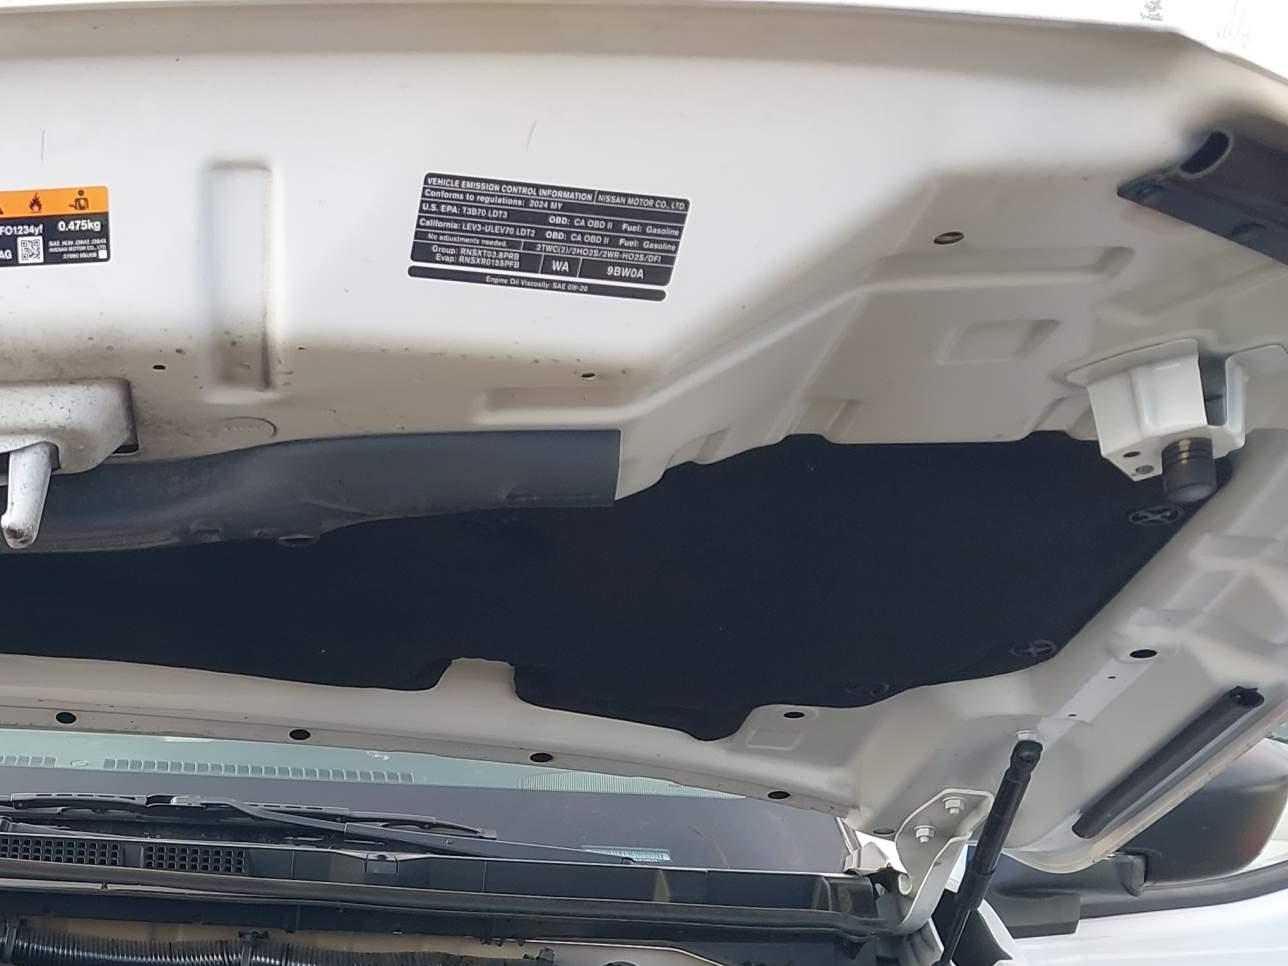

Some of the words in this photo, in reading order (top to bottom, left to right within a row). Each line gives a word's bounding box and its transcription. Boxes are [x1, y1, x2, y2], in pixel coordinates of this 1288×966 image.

[427, 177, 459, 187] VEHICLE
[462, 181, 499, 191] EMISSION
[502, 185, 536, 195] CONTROL
[539, 188, 592, 201] INFORMATION
[425, 189, 464, 199] Conforms
[466, 193, 474, 201] to
[477, 195, 525, 206] regulations:
[529, 200, 547, 208] 2024
[550, 202, 563, 210] MY
[598, 194, 626, 204] NISSAN
[627, 197, 654, 207] MOTOR
[671, 202, 685, 210] LTD.
[422, 203, 438, 211] U.S.
[441, 205, 460, 213] EPA:
[488, 210, 507, 218] LDT3
[57, 220, 101, 232] 0.475kg
[419, 218, 460, 229] California:
[462, 223, 514, 234] LEV3-ULEV70
[516, 228, 536, 237] LDT2
[549, 215, 570, 225] OBD:
[574, 218, 585, 226] CA
[587, 219, 605, 228] OBD
[622, 223, 642, 232] Fuel:
[646, 226, 680, 236] Gasoline
[439, 234, 480, 245] adjustments
[481, 239, 507, 247] needed.
[546, 231, 566, 240] OBD:
[571, 234, 582, 242] CA
[584, 234, 602, 243] OBD
[432, 245, 458, 255] Group:
[619, 238, 639, 247] Fuel:
[643, 241, 676, 251] Gasoline
[435, 254, 456, 263] Evap:
[552, 260, 569, 272] WA
[486, 276, 508, 284] Engine
[521, 279, 551, 288] Viscosity:
